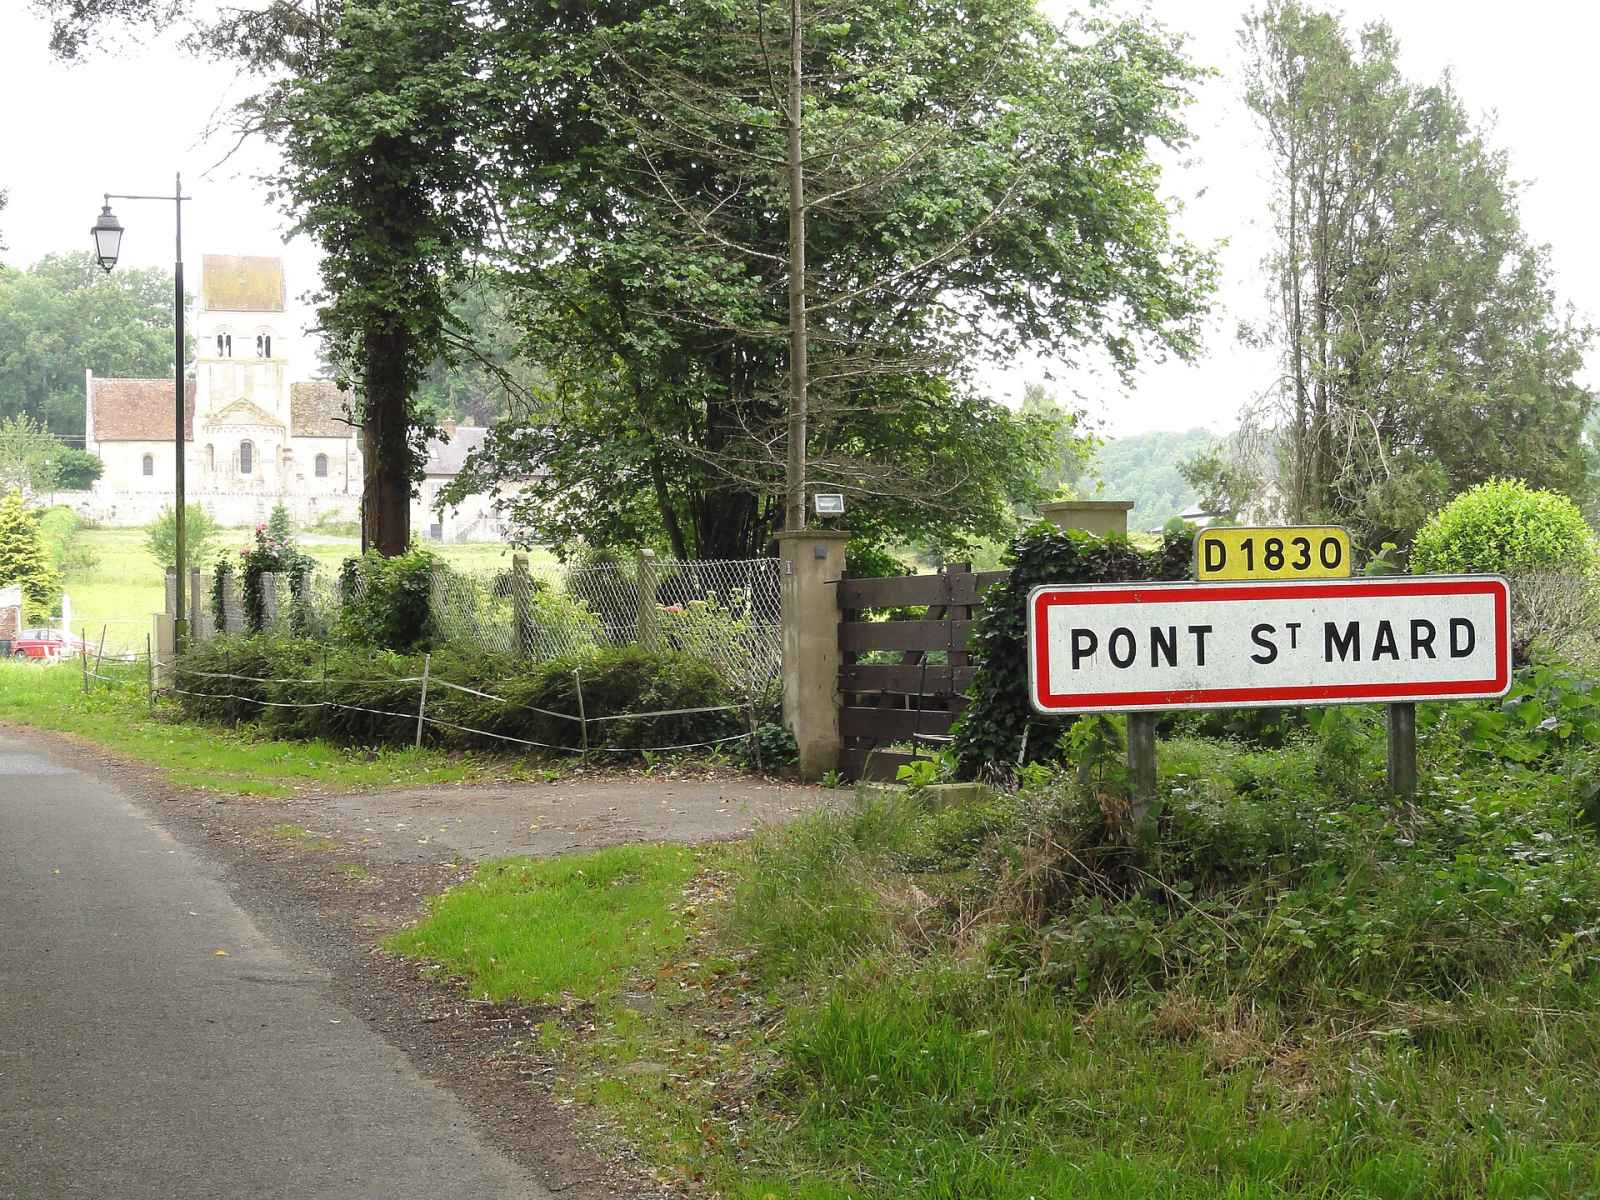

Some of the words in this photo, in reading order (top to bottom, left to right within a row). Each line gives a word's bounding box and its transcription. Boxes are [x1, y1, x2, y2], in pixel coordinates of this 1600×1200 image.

[1204, 538, 1227, 572] D
[1240, 536, 1342, 571] 1830
[1071, 625, 1213, 670] PONT
[1324, 617, 1476, 663] MARD
